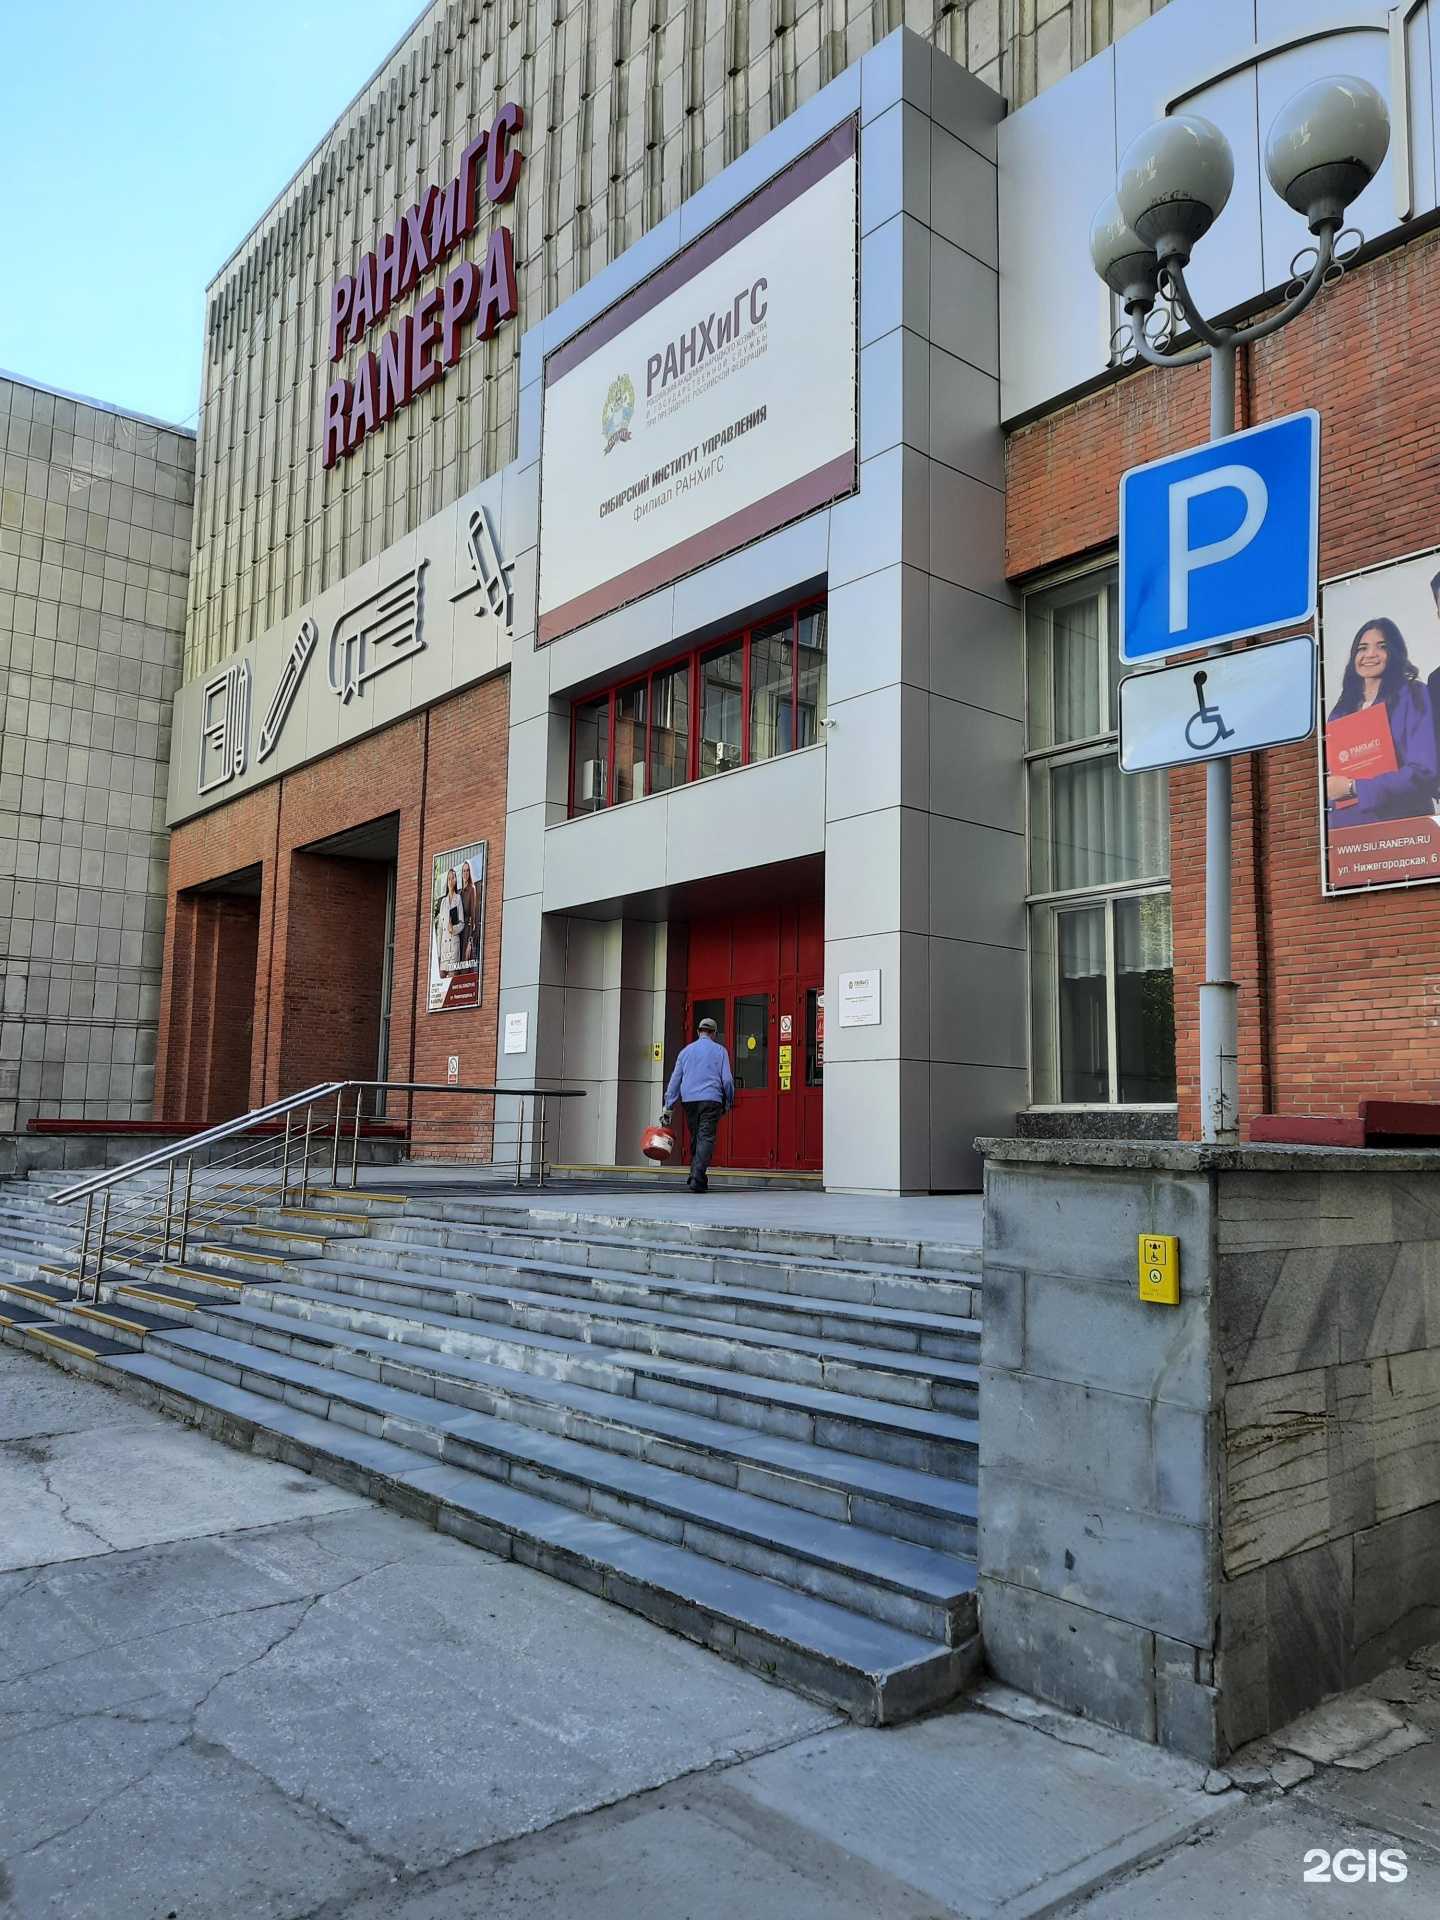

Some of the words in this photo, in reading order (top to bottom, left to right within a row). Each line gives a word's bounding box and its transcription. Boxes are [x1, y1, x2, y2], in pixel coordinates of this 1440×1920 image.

[330, 102, 524, 363] РАНХиГС
[322, 226, 518, 470] RANEPA
[646, 277, 768, 397] РАНХиГС
[600, 473, 650, 518] СИБИРСКИЙ
[652, 445, 699, 488] ИНСТИТУТ
[702, 404, 767, 457] УПРАВЛЕНИЯ
[633, 489, 673, 522] филиал
[676, 455, 724, 496] РАНХиГС
[1168, 464, 1269, 633] P
[1337, 835, 1431, 855] WWW.SIU.RANEPA.RU
[1337, 865, 1351, 877] ул.
[1353, 856, 1429, 873] Нижегородская,
[1431, 853, 1438, 864] 6
